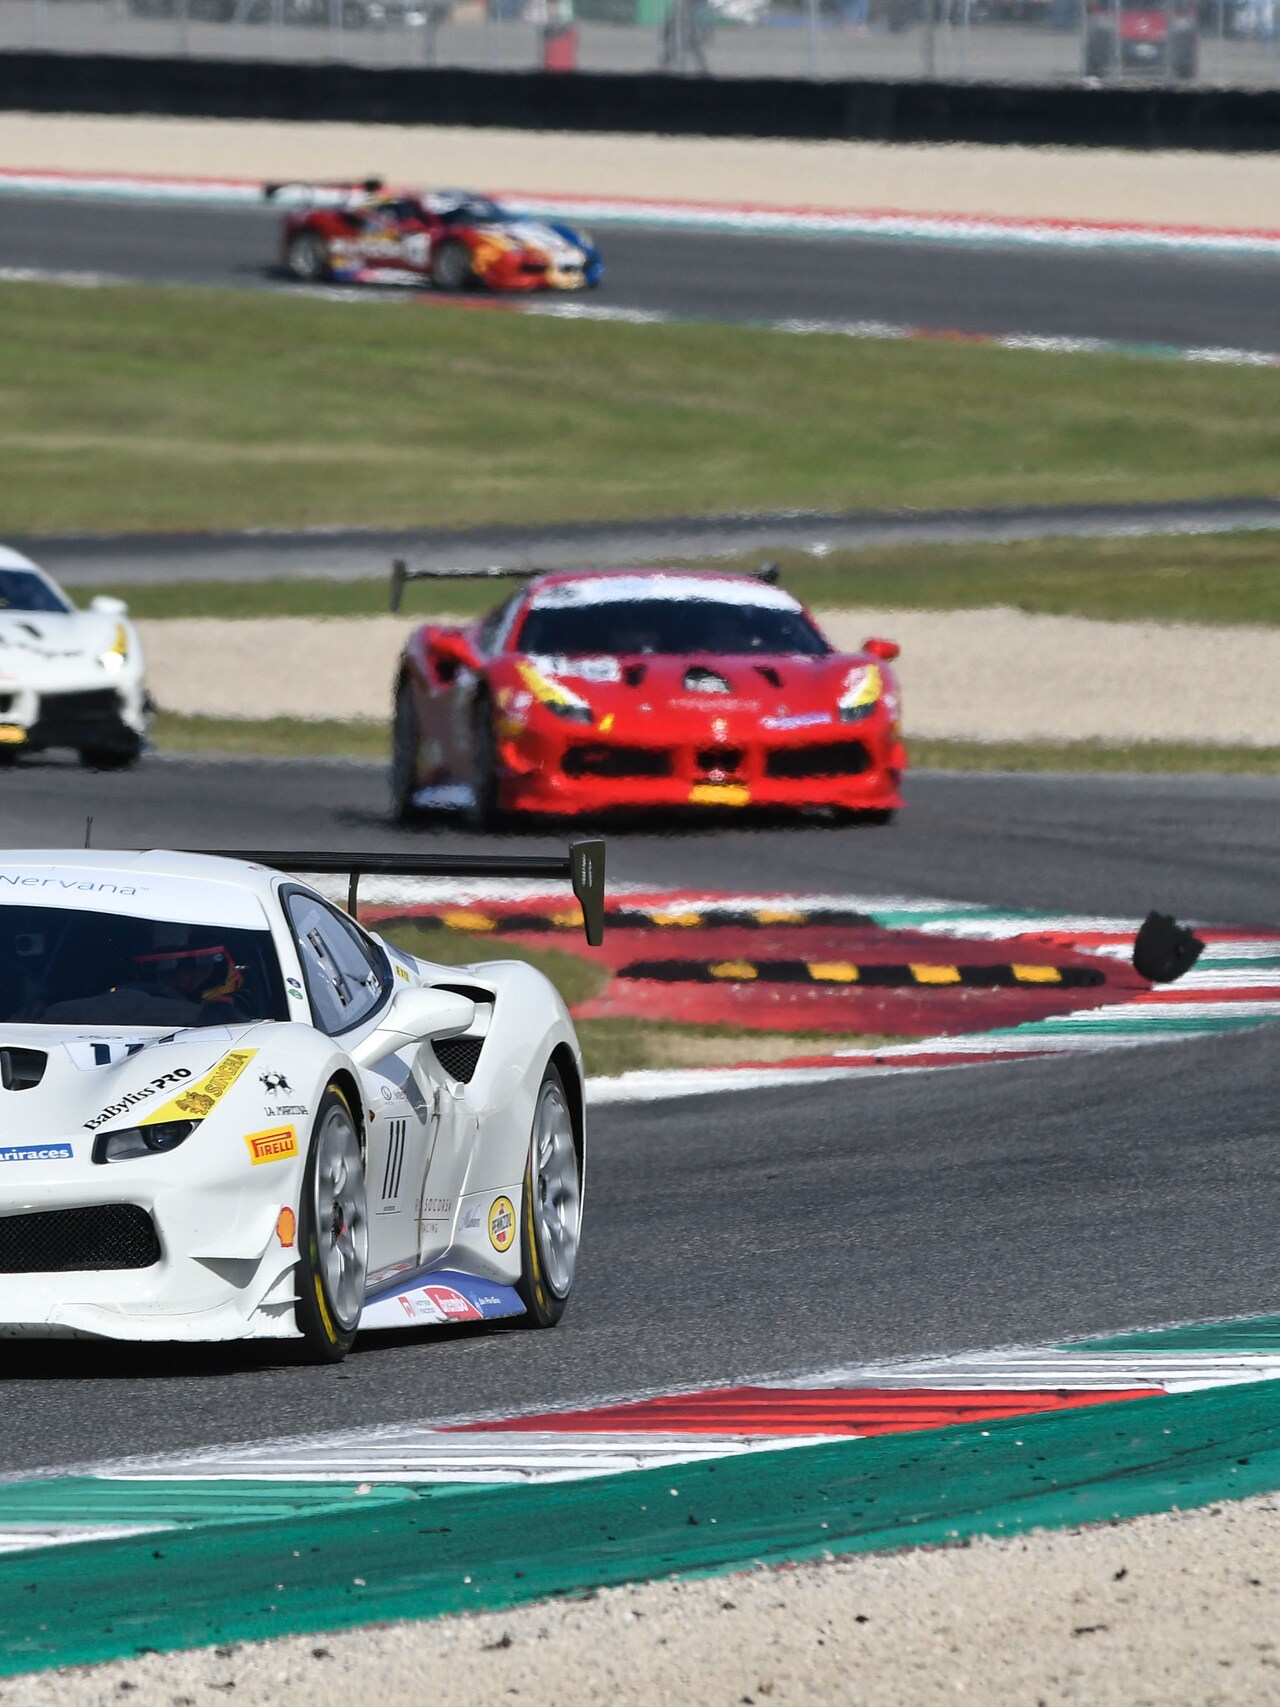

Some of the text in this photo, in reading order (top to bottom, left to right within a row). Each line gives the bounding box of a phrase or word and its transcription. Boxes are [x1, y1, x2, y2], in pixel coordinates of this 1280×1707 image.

[204, 1053, 248, 1098] SINGHA
[83, 1068, 192, 1131] BaByliss PRO
[250, 1131, 294, 1158] PIRELLI
